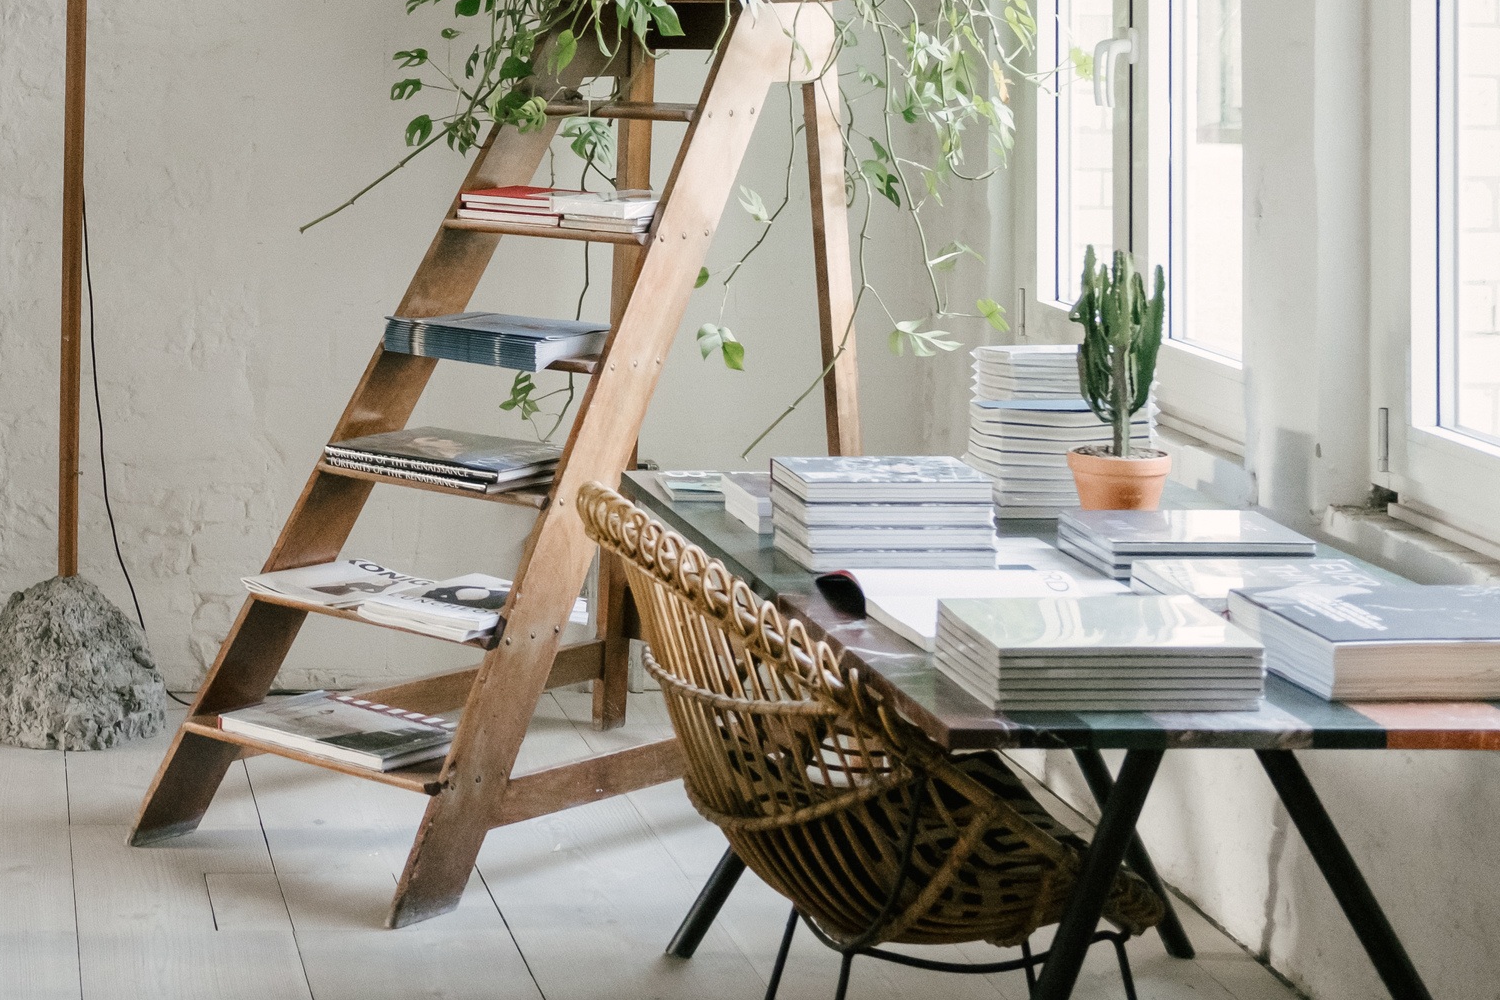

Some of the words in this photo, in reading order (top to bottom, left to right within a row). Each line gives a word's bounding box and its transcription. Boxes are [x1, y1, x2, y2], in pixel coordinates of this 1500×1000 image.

[329, 448, 373, 462] PORTRAITS
[376, 454, 387, 464] OF
[391, 457, 408, 468] THE
[410, 459, 469, 477] RENAISSANCE
[330, 458, 371, 472] PORTRAITS
[374, 464, 385, 475] OF
[387, 468, 404, 478] THE
[406, 471, 459, 489] RENAISSANCE
